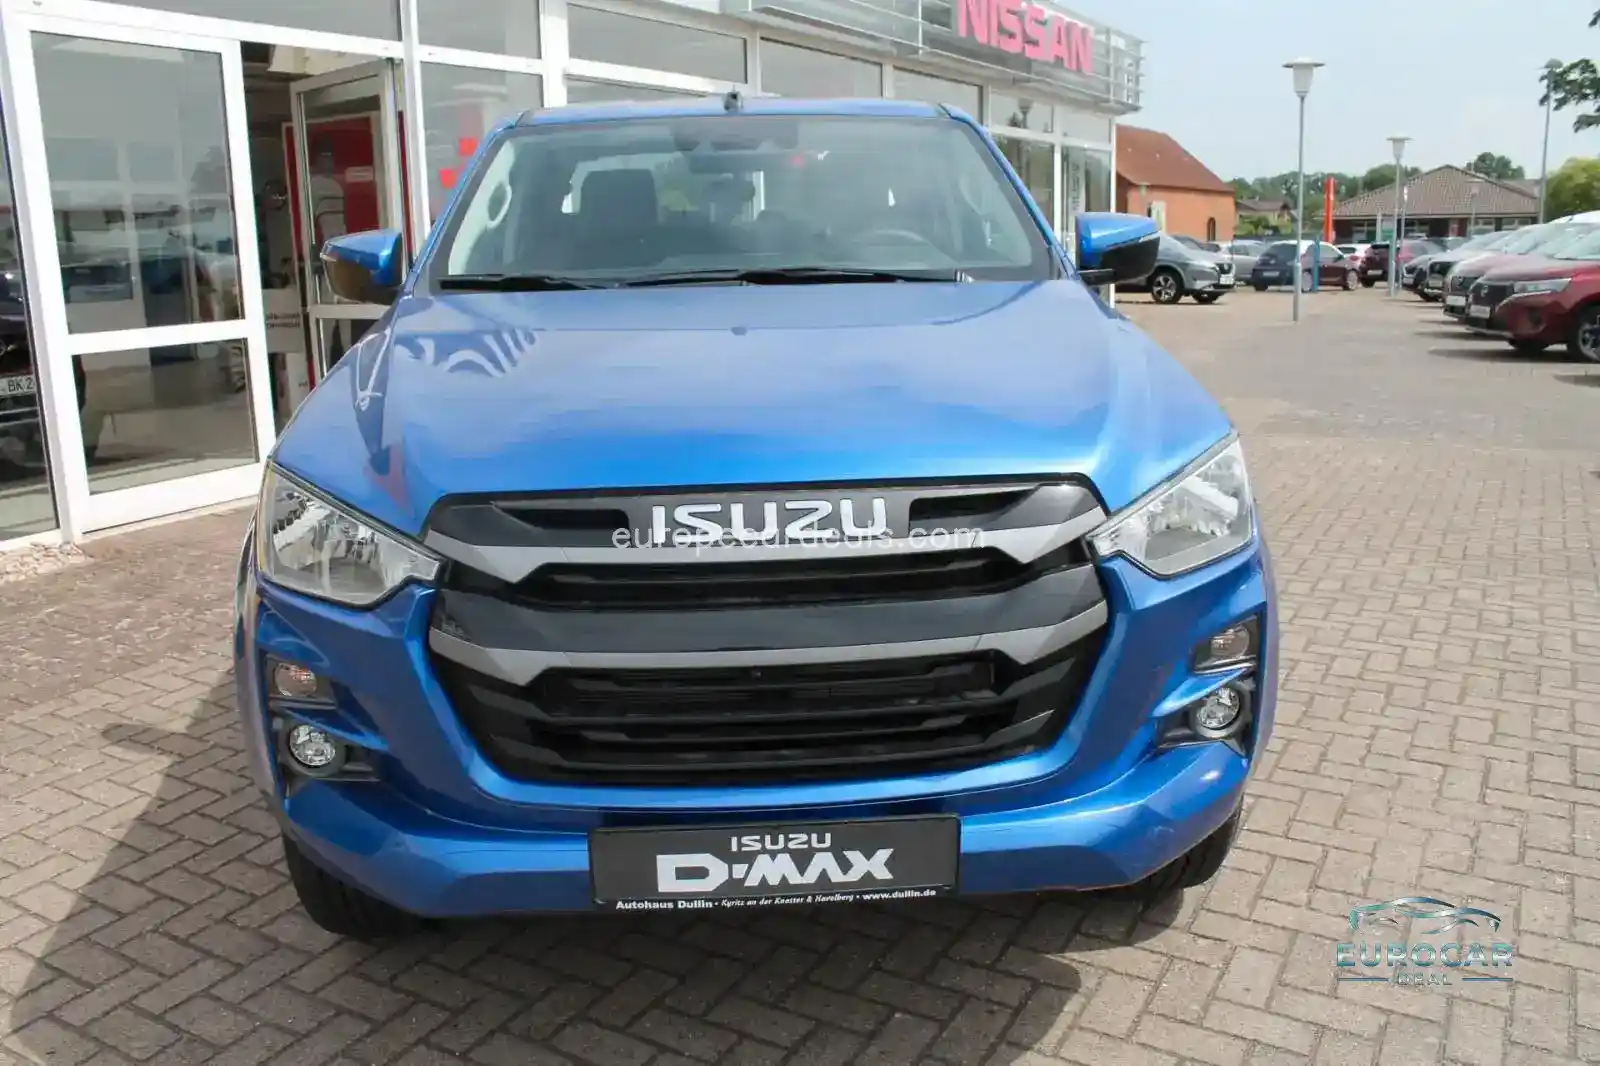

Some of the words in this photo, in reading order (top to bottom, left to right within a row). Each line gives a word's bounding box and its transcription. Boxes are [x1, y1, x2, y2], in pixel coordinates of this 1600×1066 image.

[956, 0, 1093, 74] NISSAN
[651, 497, 887, 544] ISUZU
[730, 832, 832, 852] ISUZU
[656, 848, 894, 893] D-MAX
[615, 900, 674, 910] Autohaus
[677, 898, 713, 909] Dullin
[861, 888, 937, 900] www.dullin.de
